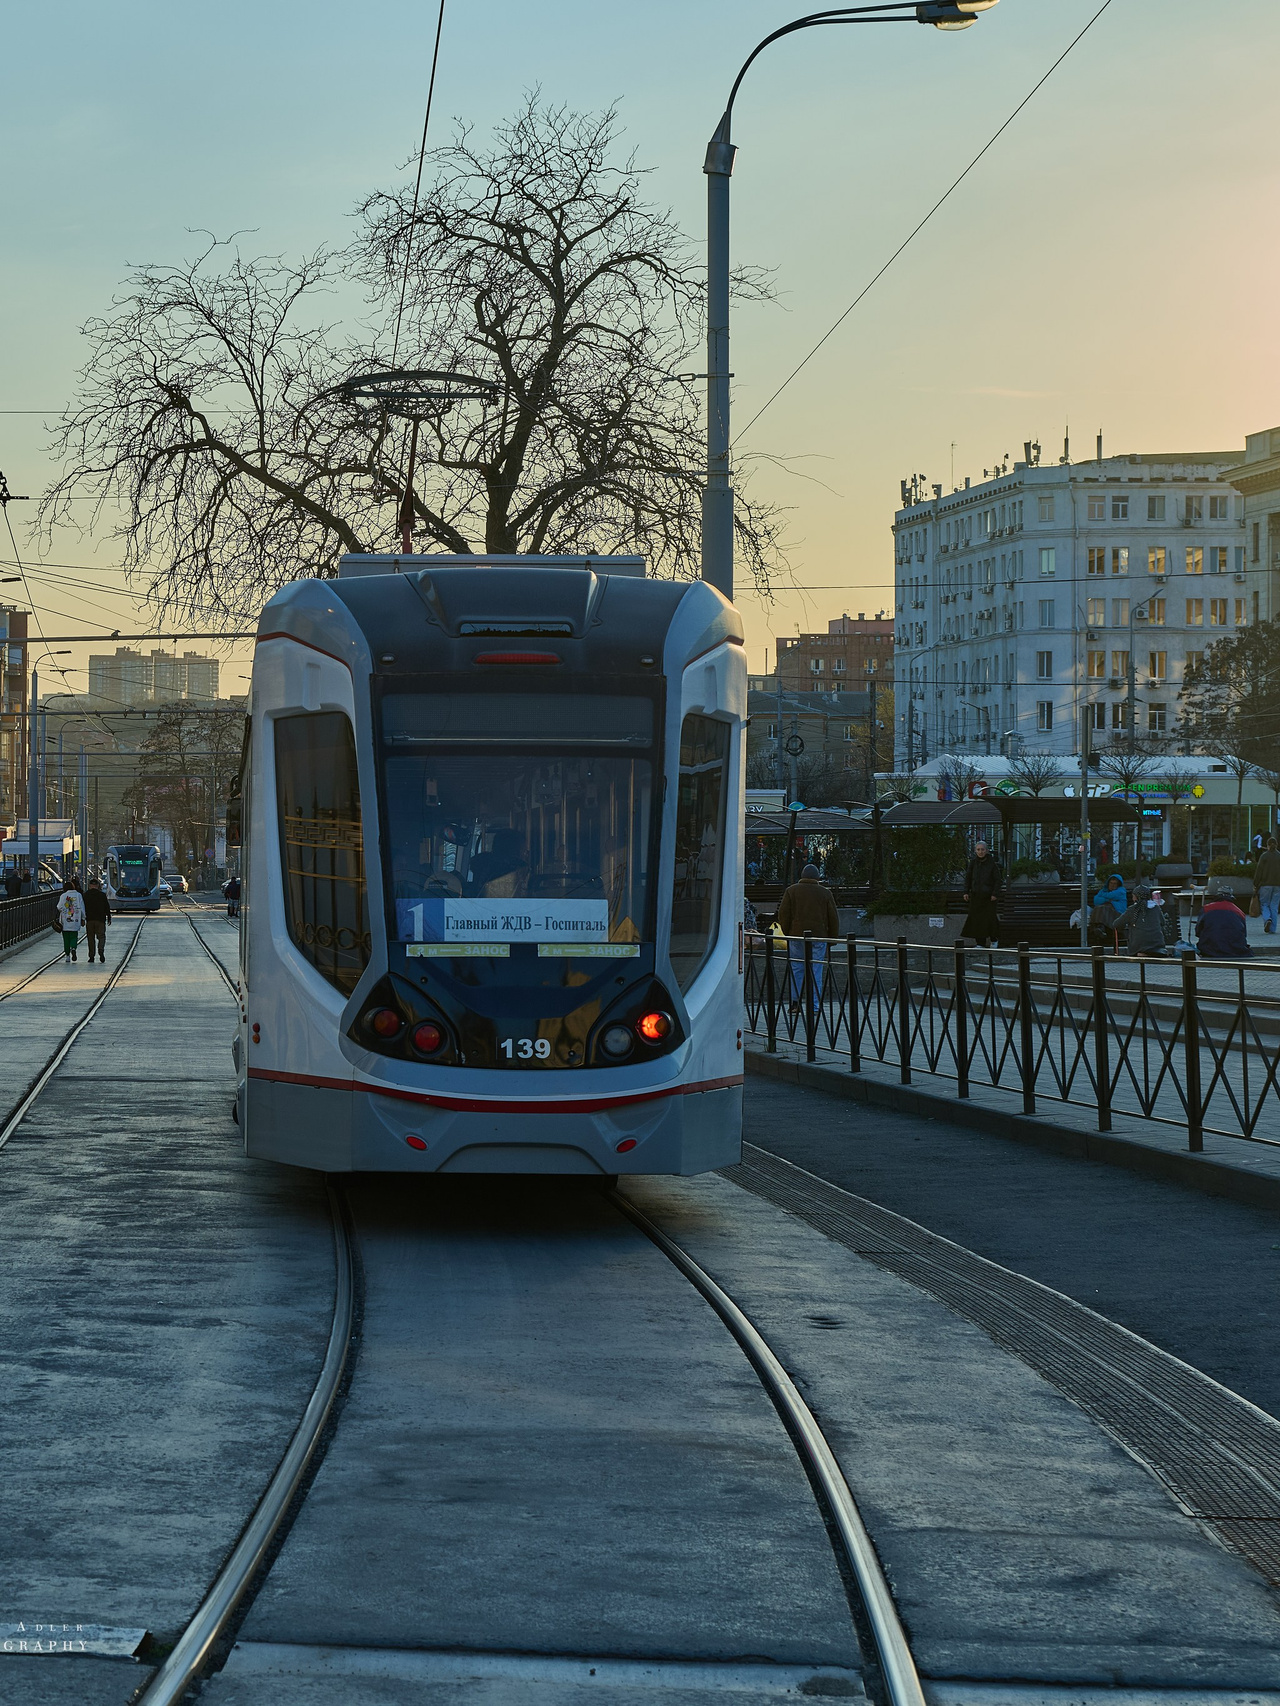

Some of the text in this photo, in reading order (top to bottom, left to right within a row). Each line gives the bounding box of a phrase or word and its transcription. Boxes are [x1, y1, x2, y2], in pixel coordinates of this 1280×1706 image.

[445, 915, 606, 933] Главный ЖДВ Госпиталь
[464, 946, 508, 955] ЗАНОС
[542, 946, 550, 955] 2
[588, 946, 630, 956] ЗАНОС
[500, 1038, 551, 1059] 139
